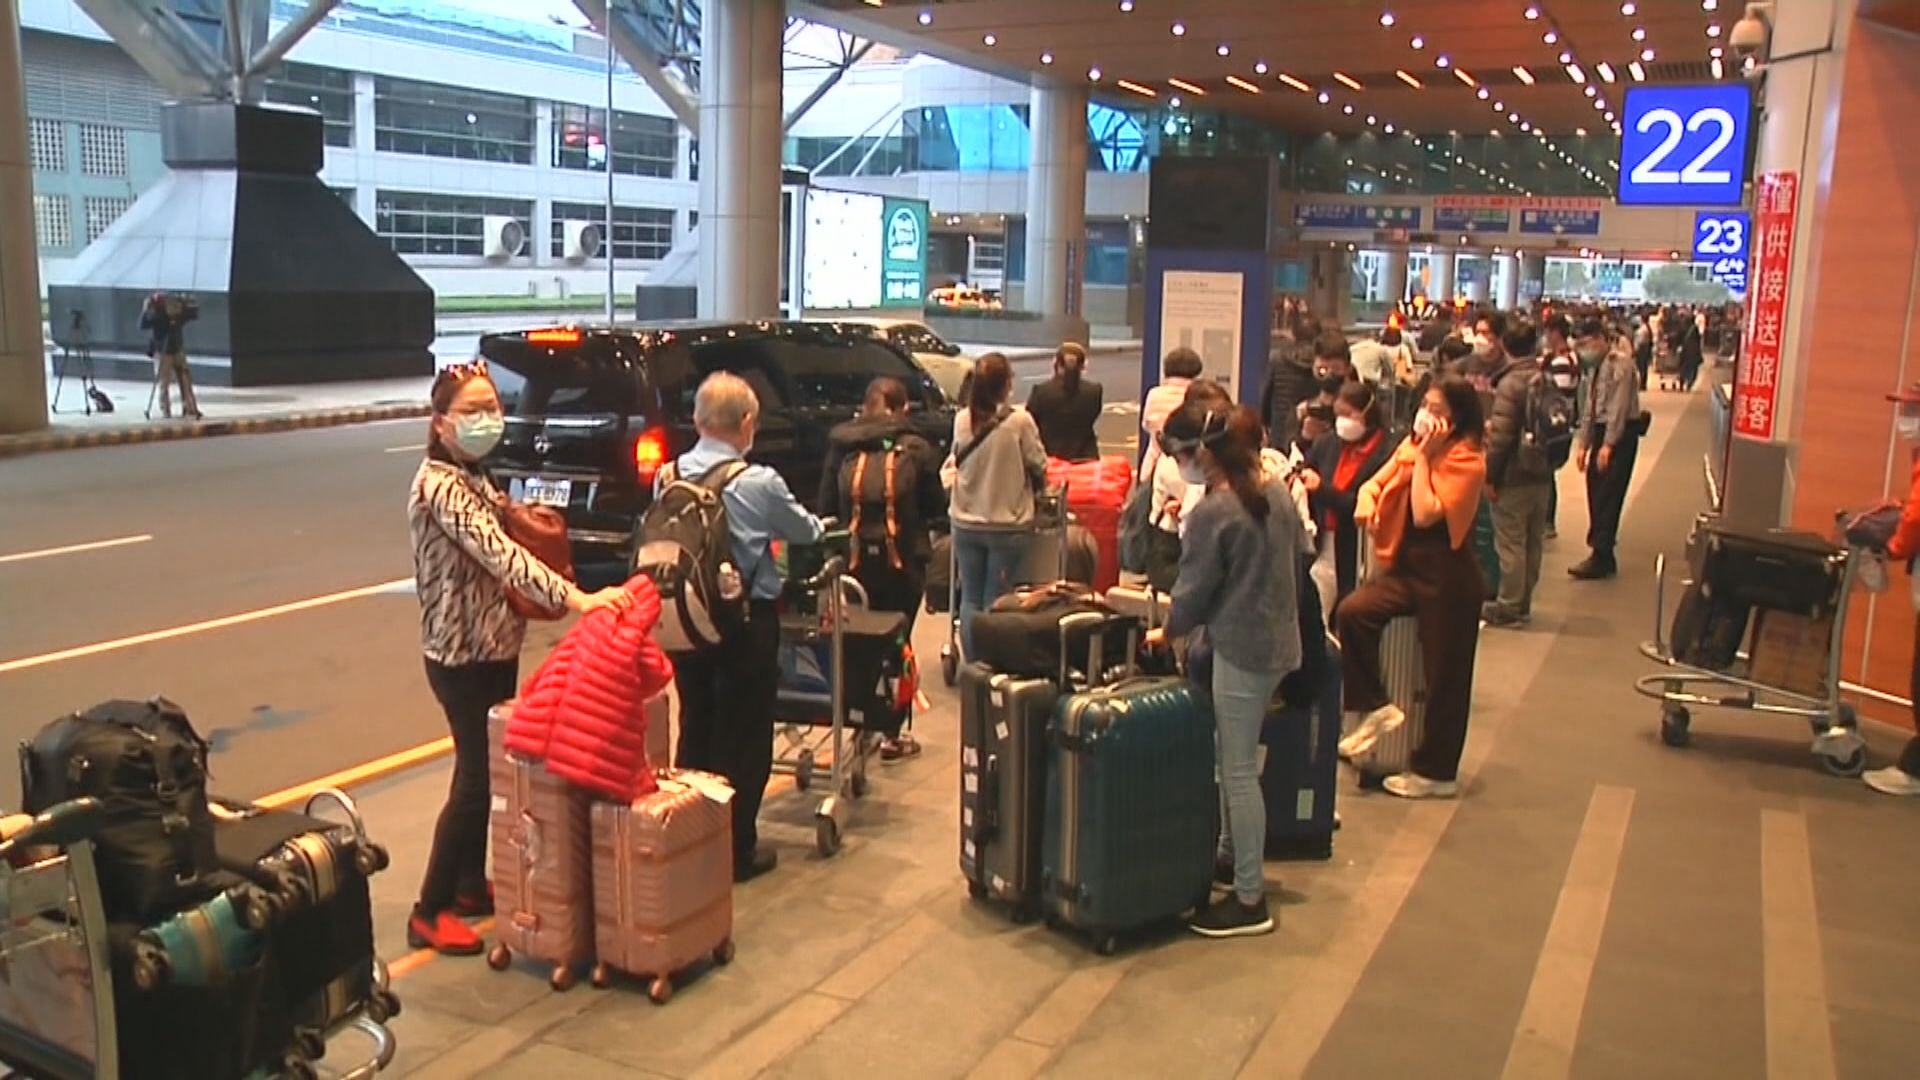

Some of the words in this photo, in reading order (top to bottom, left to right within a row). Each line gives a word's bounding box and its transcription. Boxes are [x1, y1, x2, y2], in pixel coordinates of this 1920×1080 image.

[1630, 107, 1735, 184] 22
[1697, 218, 1743, 253] 23
[1748, 174, 1793, 431] 僅供接送旅客
